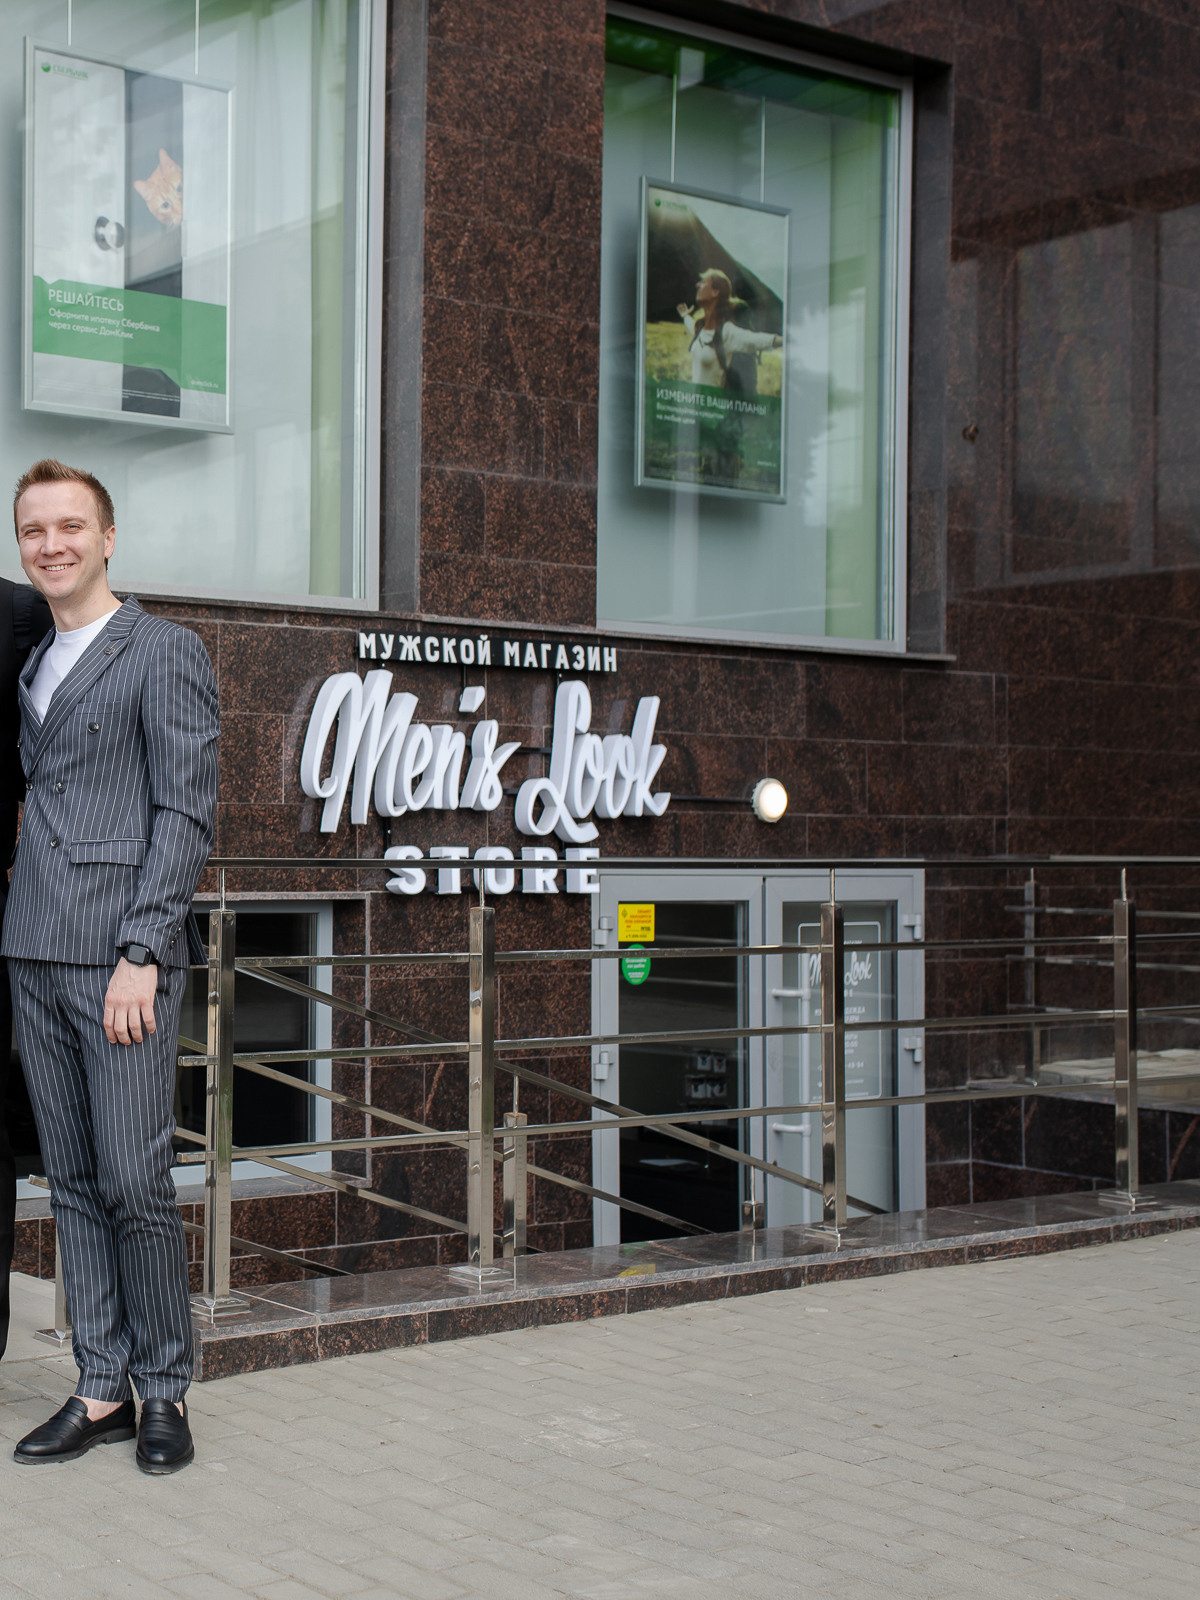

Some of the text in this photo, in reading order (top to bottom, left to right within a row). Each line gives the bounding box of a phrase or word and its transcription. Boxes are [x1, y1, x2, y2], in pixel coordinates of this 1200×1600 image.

[48, 288, 124, 311] РЕШАЙТЕСЬ
[48, 307, 160, 332] Оформите ипотеку Сбербанка
[48, 320, 71, 331] через
[72, 323, 98, 335] сервис
[656, 388, 767, 416] ИЗМЕНИТЕ ВАШИ ПЛАНЫ
[359, 632, 618, 673] МУЖСКОЙ МАГАЗИН
[300, 669, 672, 844] Men's Look
[384, 845, 600, 895] STORE
